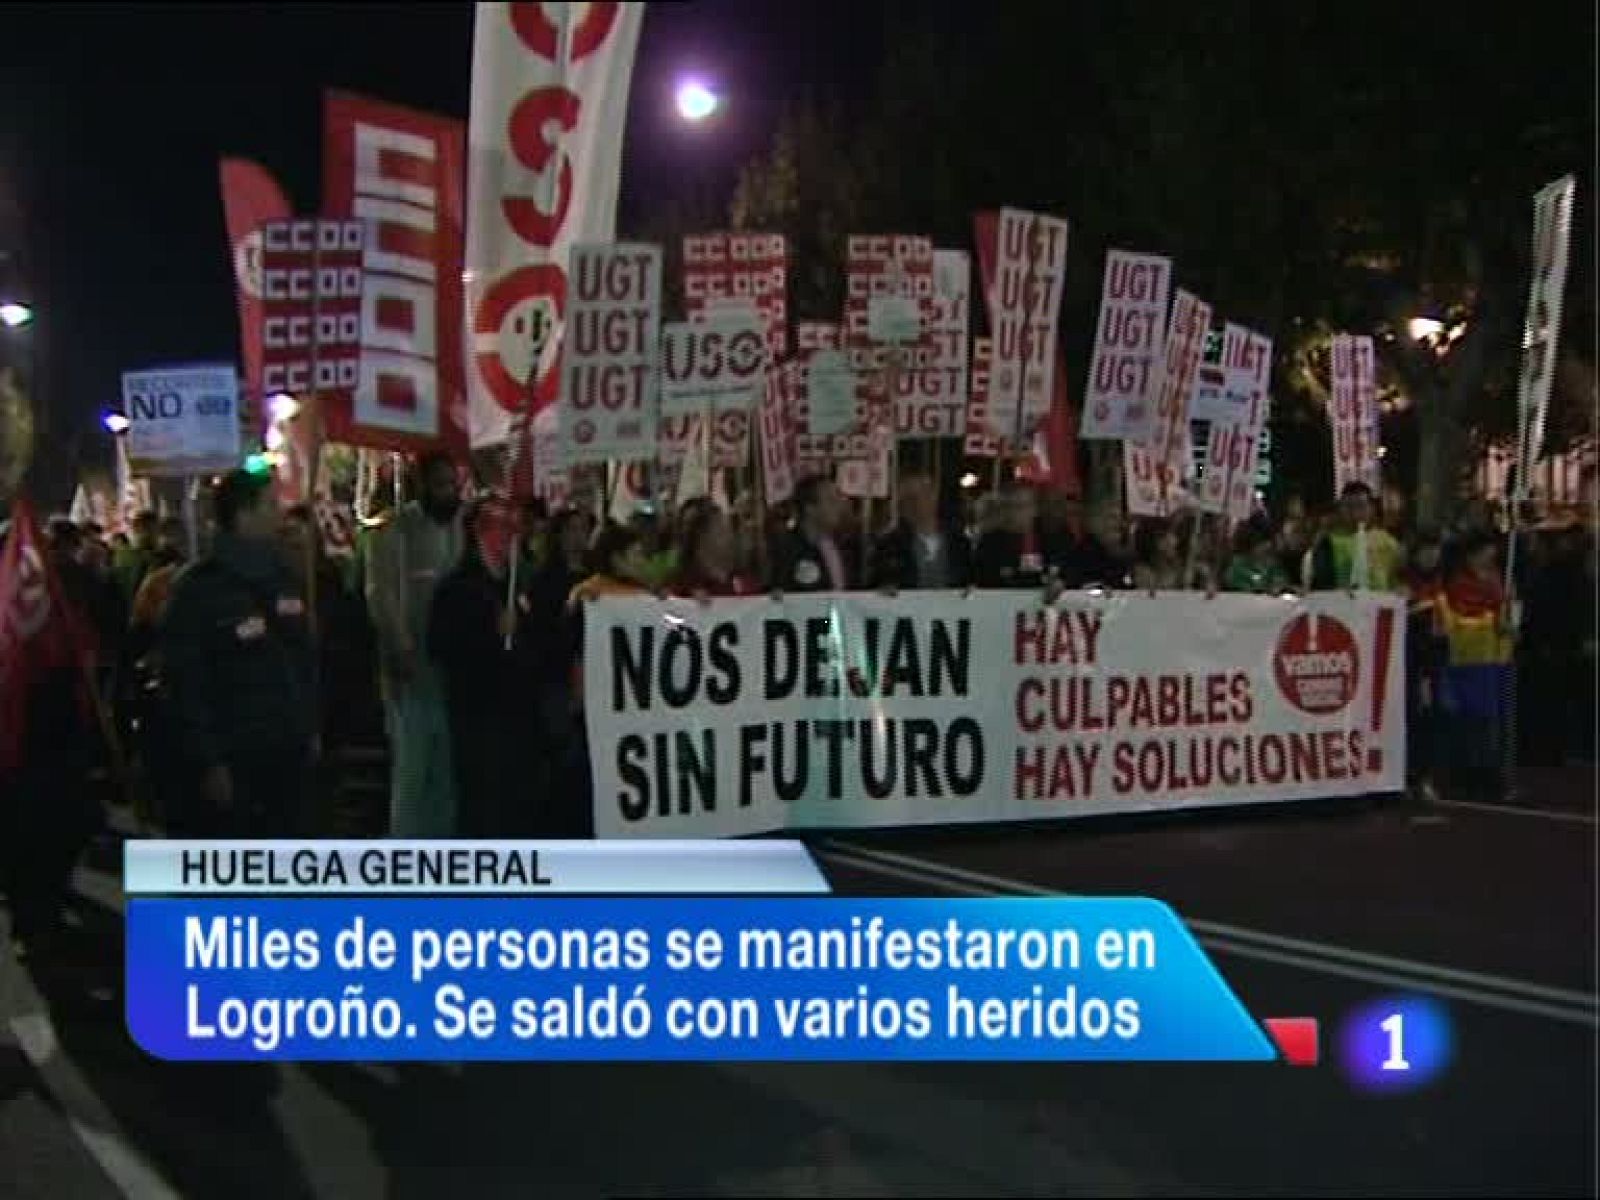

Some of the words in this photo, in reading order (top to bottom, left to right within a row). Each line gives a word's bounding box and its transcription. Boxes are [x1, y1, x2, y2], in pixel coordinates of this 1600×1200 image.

[265, 221, 363, 251] CCOO
[265, 267, 361, 298] CCOO
[577, 255, 653, 301] UGT
[1108, 259, 1163, 300] UGT
[264, 314, 360, 349] CCOO
[574, 310, 650, 356] UGT
[1102, 308, 1157, 350] UGT
[665, 331, 763, 381] USO
[1095, 356, 1150, 396] UGT
[571, 366, 650, 411] UGT
[897, 367, 964, 395] UGT
[132, 394, 182, 419] NO
[895, 403, 964, 433] UGT
[1014, 610, 1102, 665] HAY
[609, 621, 742, 712] NOS
[763, 617, 971, 699] DEJAN
[1015, 671, 1253, 732] CULPABLES
[616, 728, 717, 822] SIN
[739, 716, 985, 807] FUTURO
[1015, 743, 1101, 799] HAY
